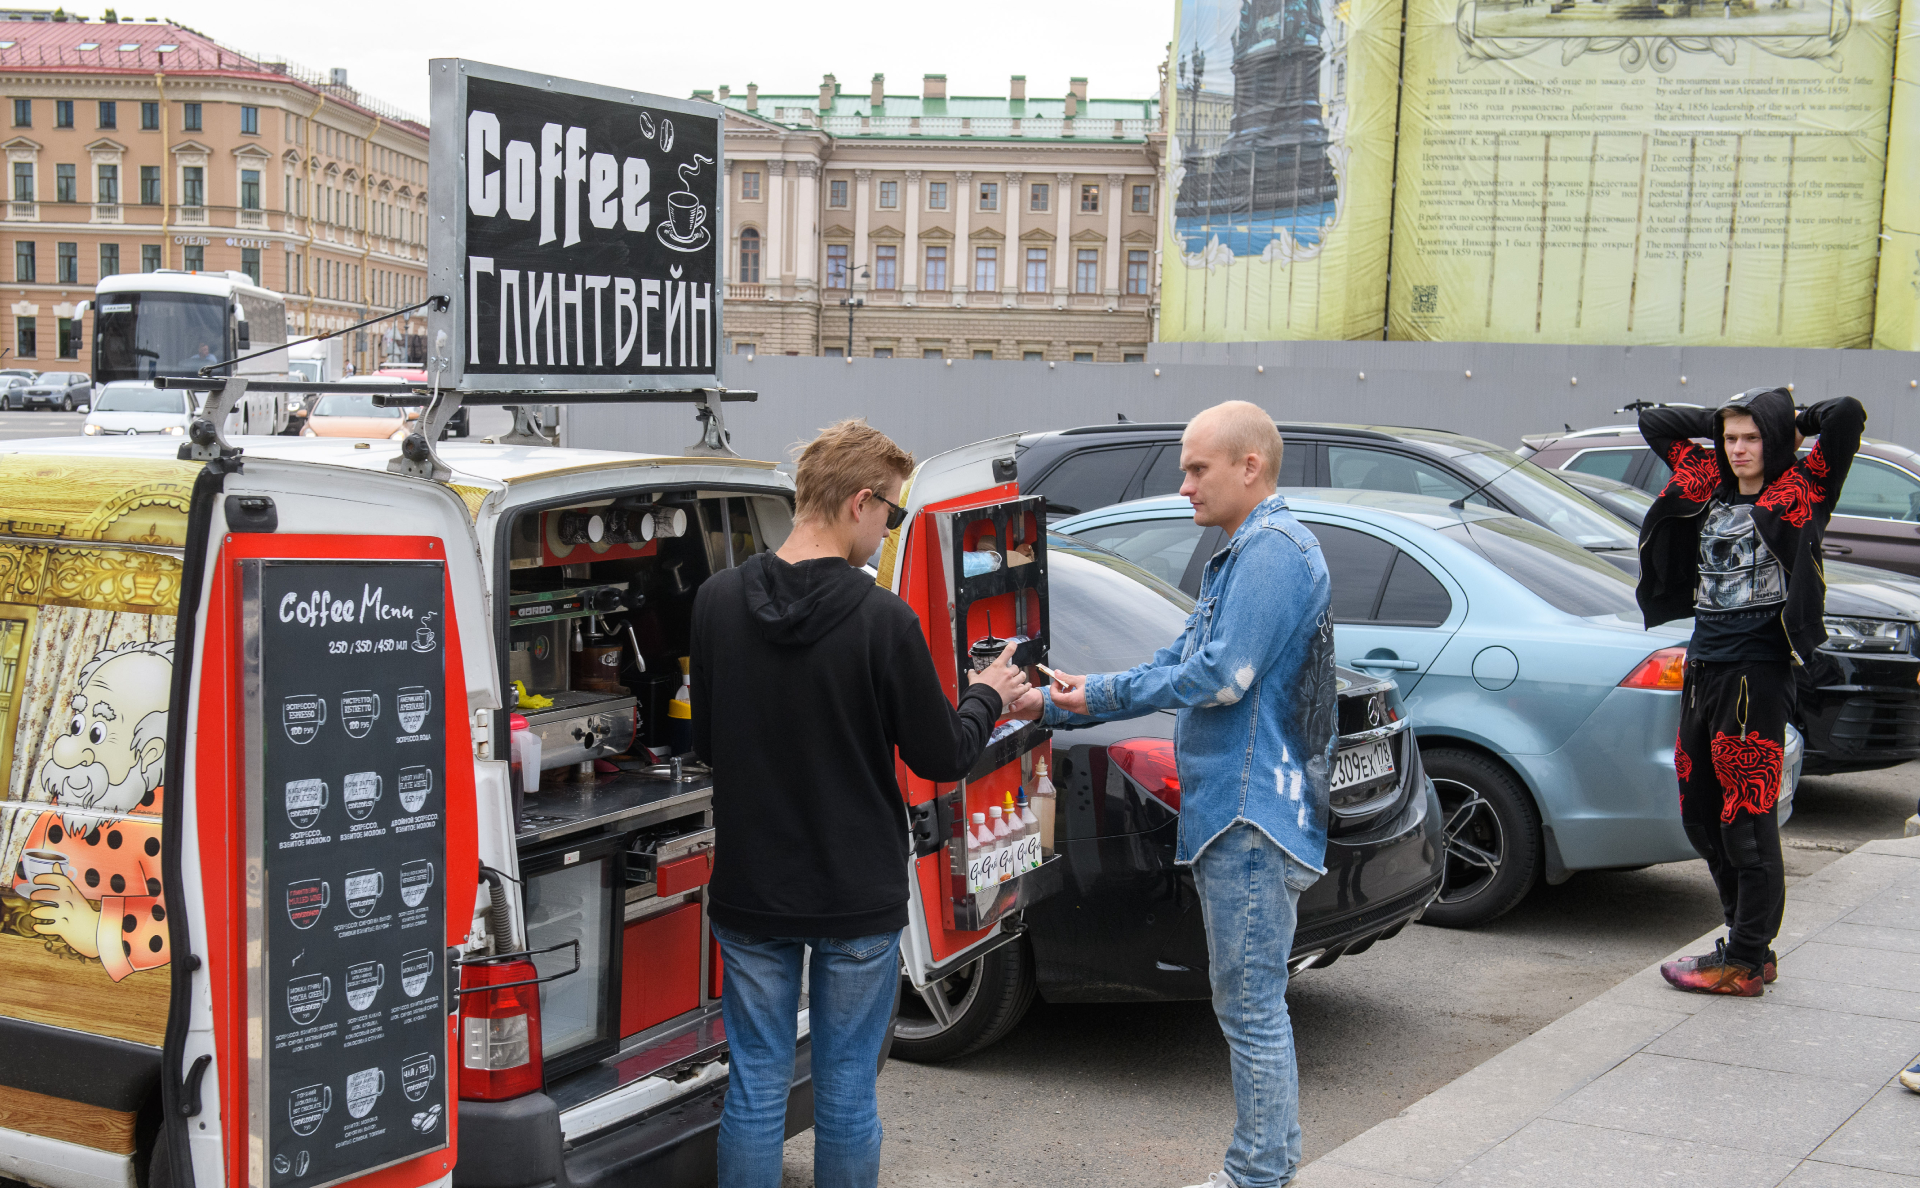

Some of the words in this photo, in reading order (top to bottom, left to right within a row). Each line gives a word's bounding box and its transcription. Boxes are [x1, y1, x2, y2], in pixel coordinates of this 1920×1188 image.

[1788, 78, 1822, 86] memory
[1655, 103, 1675, 111] May
[1711, 103, 1754, 112] leadership
[1707, 114, 1742, 122] Auguste
[468, 110, 650, 248] Coffee
[1699, 180, 1725, 189] laying
[1798, 180, 1809, 188] of
[1649, 190, 1682, 199] pedestal
[174, 236, 210, 246] ОТЕЛЬ
[234, 238, 271, 249] LOTTE
[1646, 241, 1661, 249] The
[468, 256, 712, 367] ГЛИНТВЕЙН
[279, 591, 354, 627] Coffee
[360, 583, 414, 624] Menu
[349, 721, 360, 730] 100
[290, 726, 302, 736] 100
[1374, 742, 1390, 765] 178
